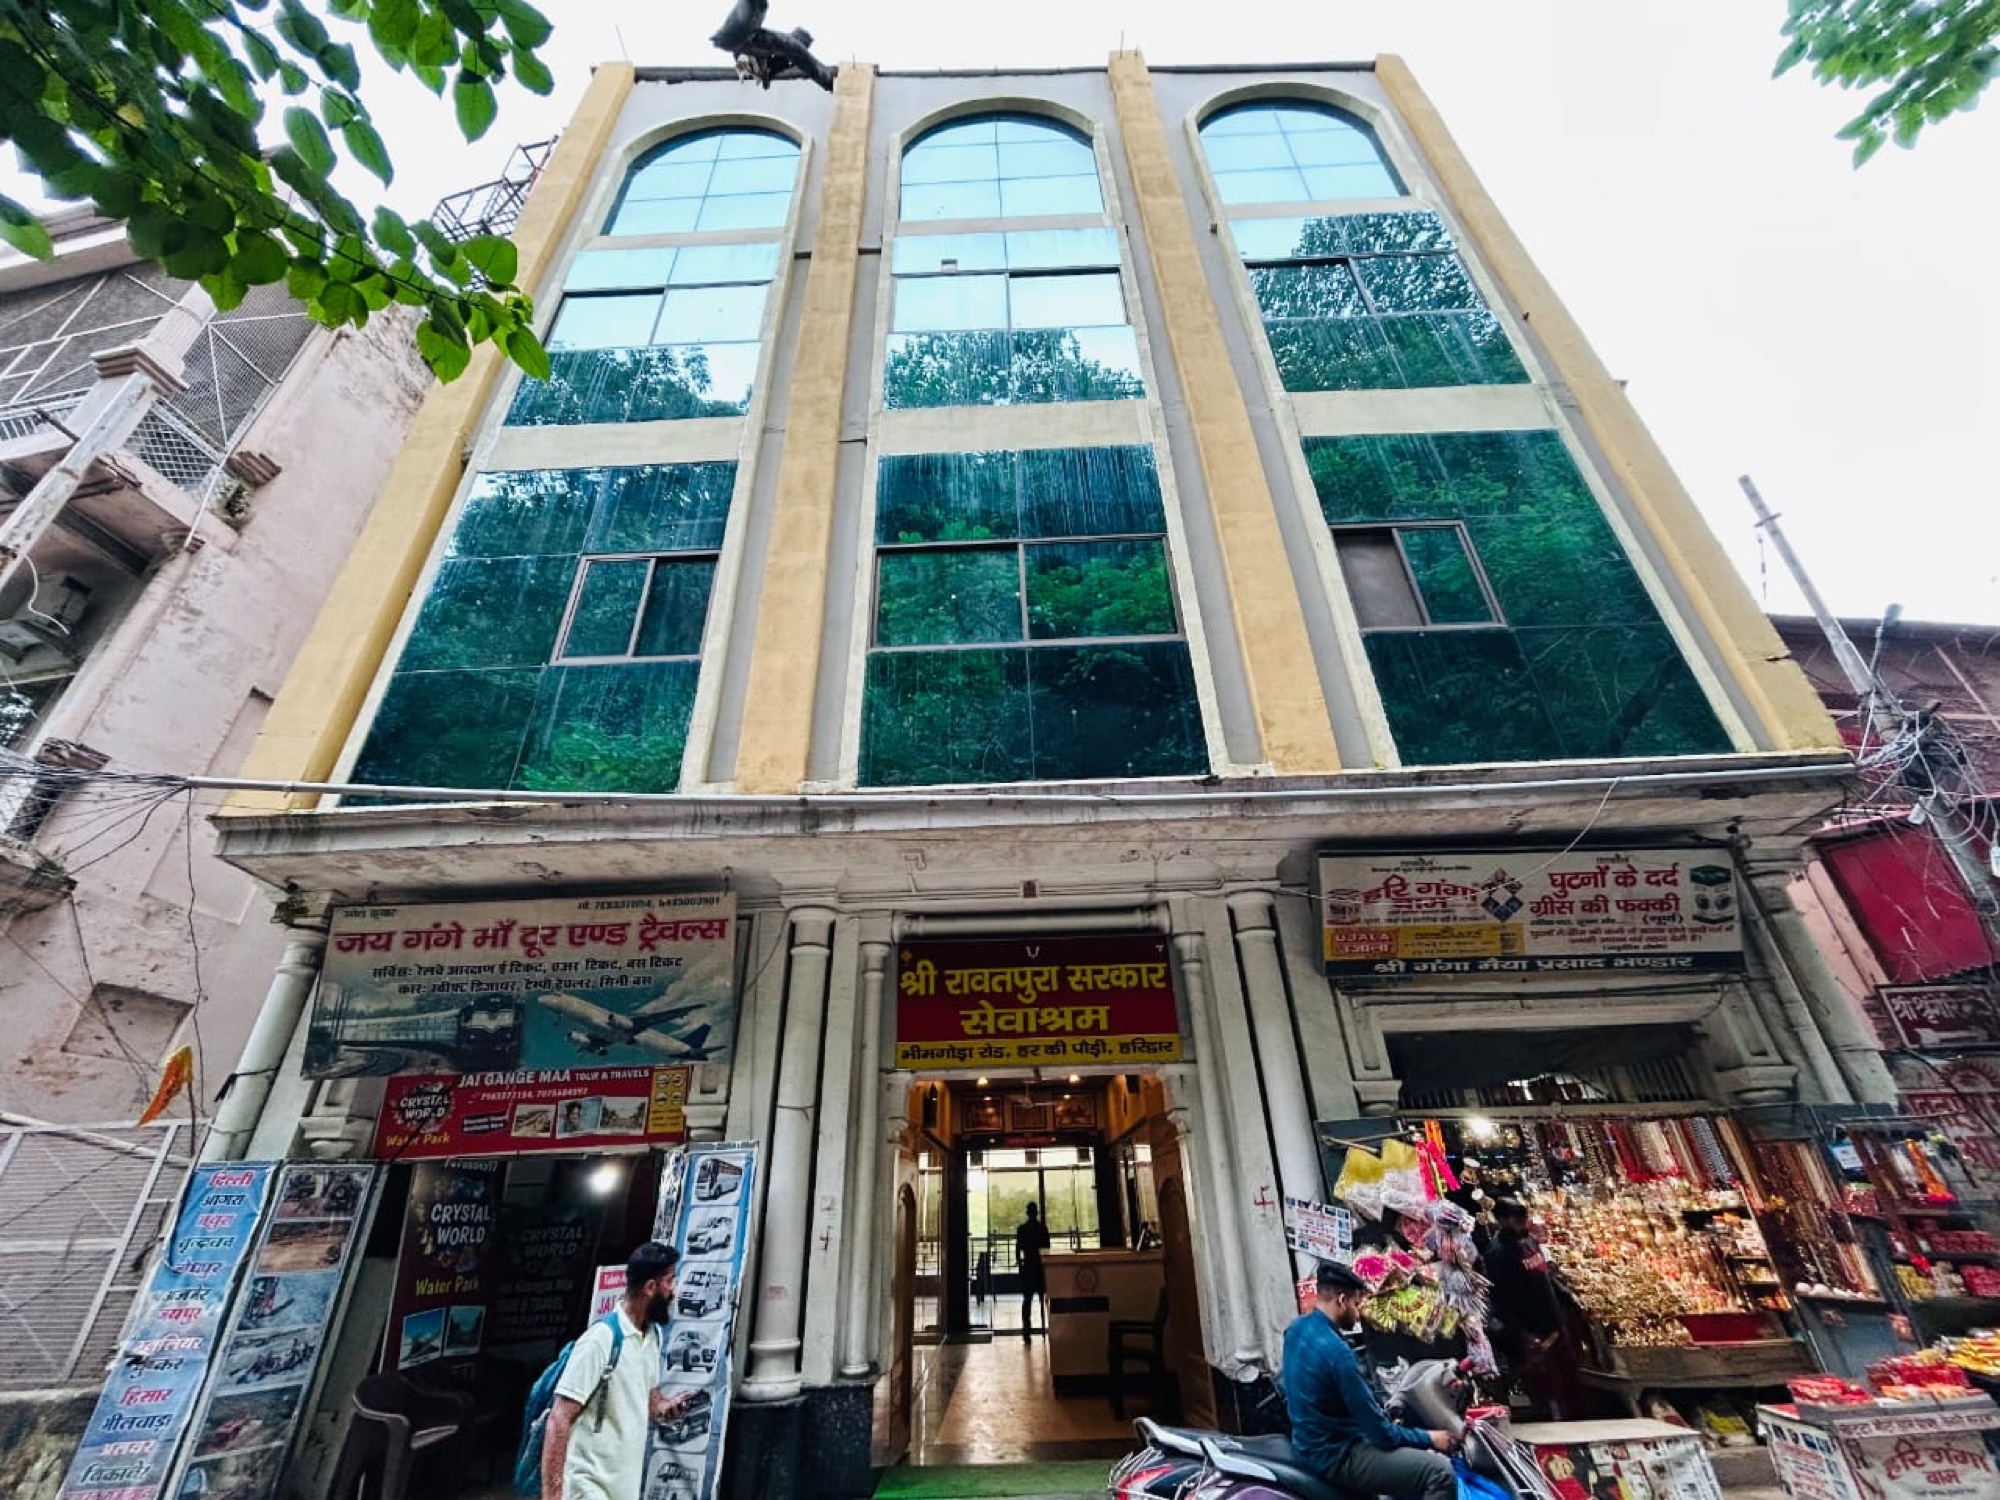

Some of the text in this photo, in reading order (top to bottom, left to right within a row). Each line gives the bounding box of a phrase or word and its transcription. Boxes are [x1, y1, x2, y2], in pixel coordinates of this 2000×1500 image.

[1548, 864, 1609, 898] घुटनों
[1612, 864, 1638, 887] के
[1644, 862, 1680, 887] दर्द
[1580, 893, 1610, 914] की
[334, 931, 397, 952] जय
[402, 921, 466, 951] गंगे
[519, 924, 562, 958] टूर
[566, 923, 631, 948] एण्ड
[1413, 958, 1470, 973] गंगा
[900, 959, 1167, 1004] श्री रावतपुरा सरकार
[959, 1000, 1111, 1035] सेवाश्रम
[1016, 1044, 1041, 1058] हर
[1043, 1039, 1067, 1055] की
[458, 1073, 481, 1089] JAI
[483, 1071, 536, 1086] GANGE
[537, 1069, 571, 1084] MAA
[424, 1132, 451, 1145] Park
[210, 1170, 254, 1187] दिल्ली
[203, 1194, 246, 1207] आगरा
[430, 1202, 491, 1224] CRYSTAL
[437, 1225, 486, 1247] WORLD
[415, 1278, 453, 1297] Water
[120, 1385, 174, 1406] हिसार
